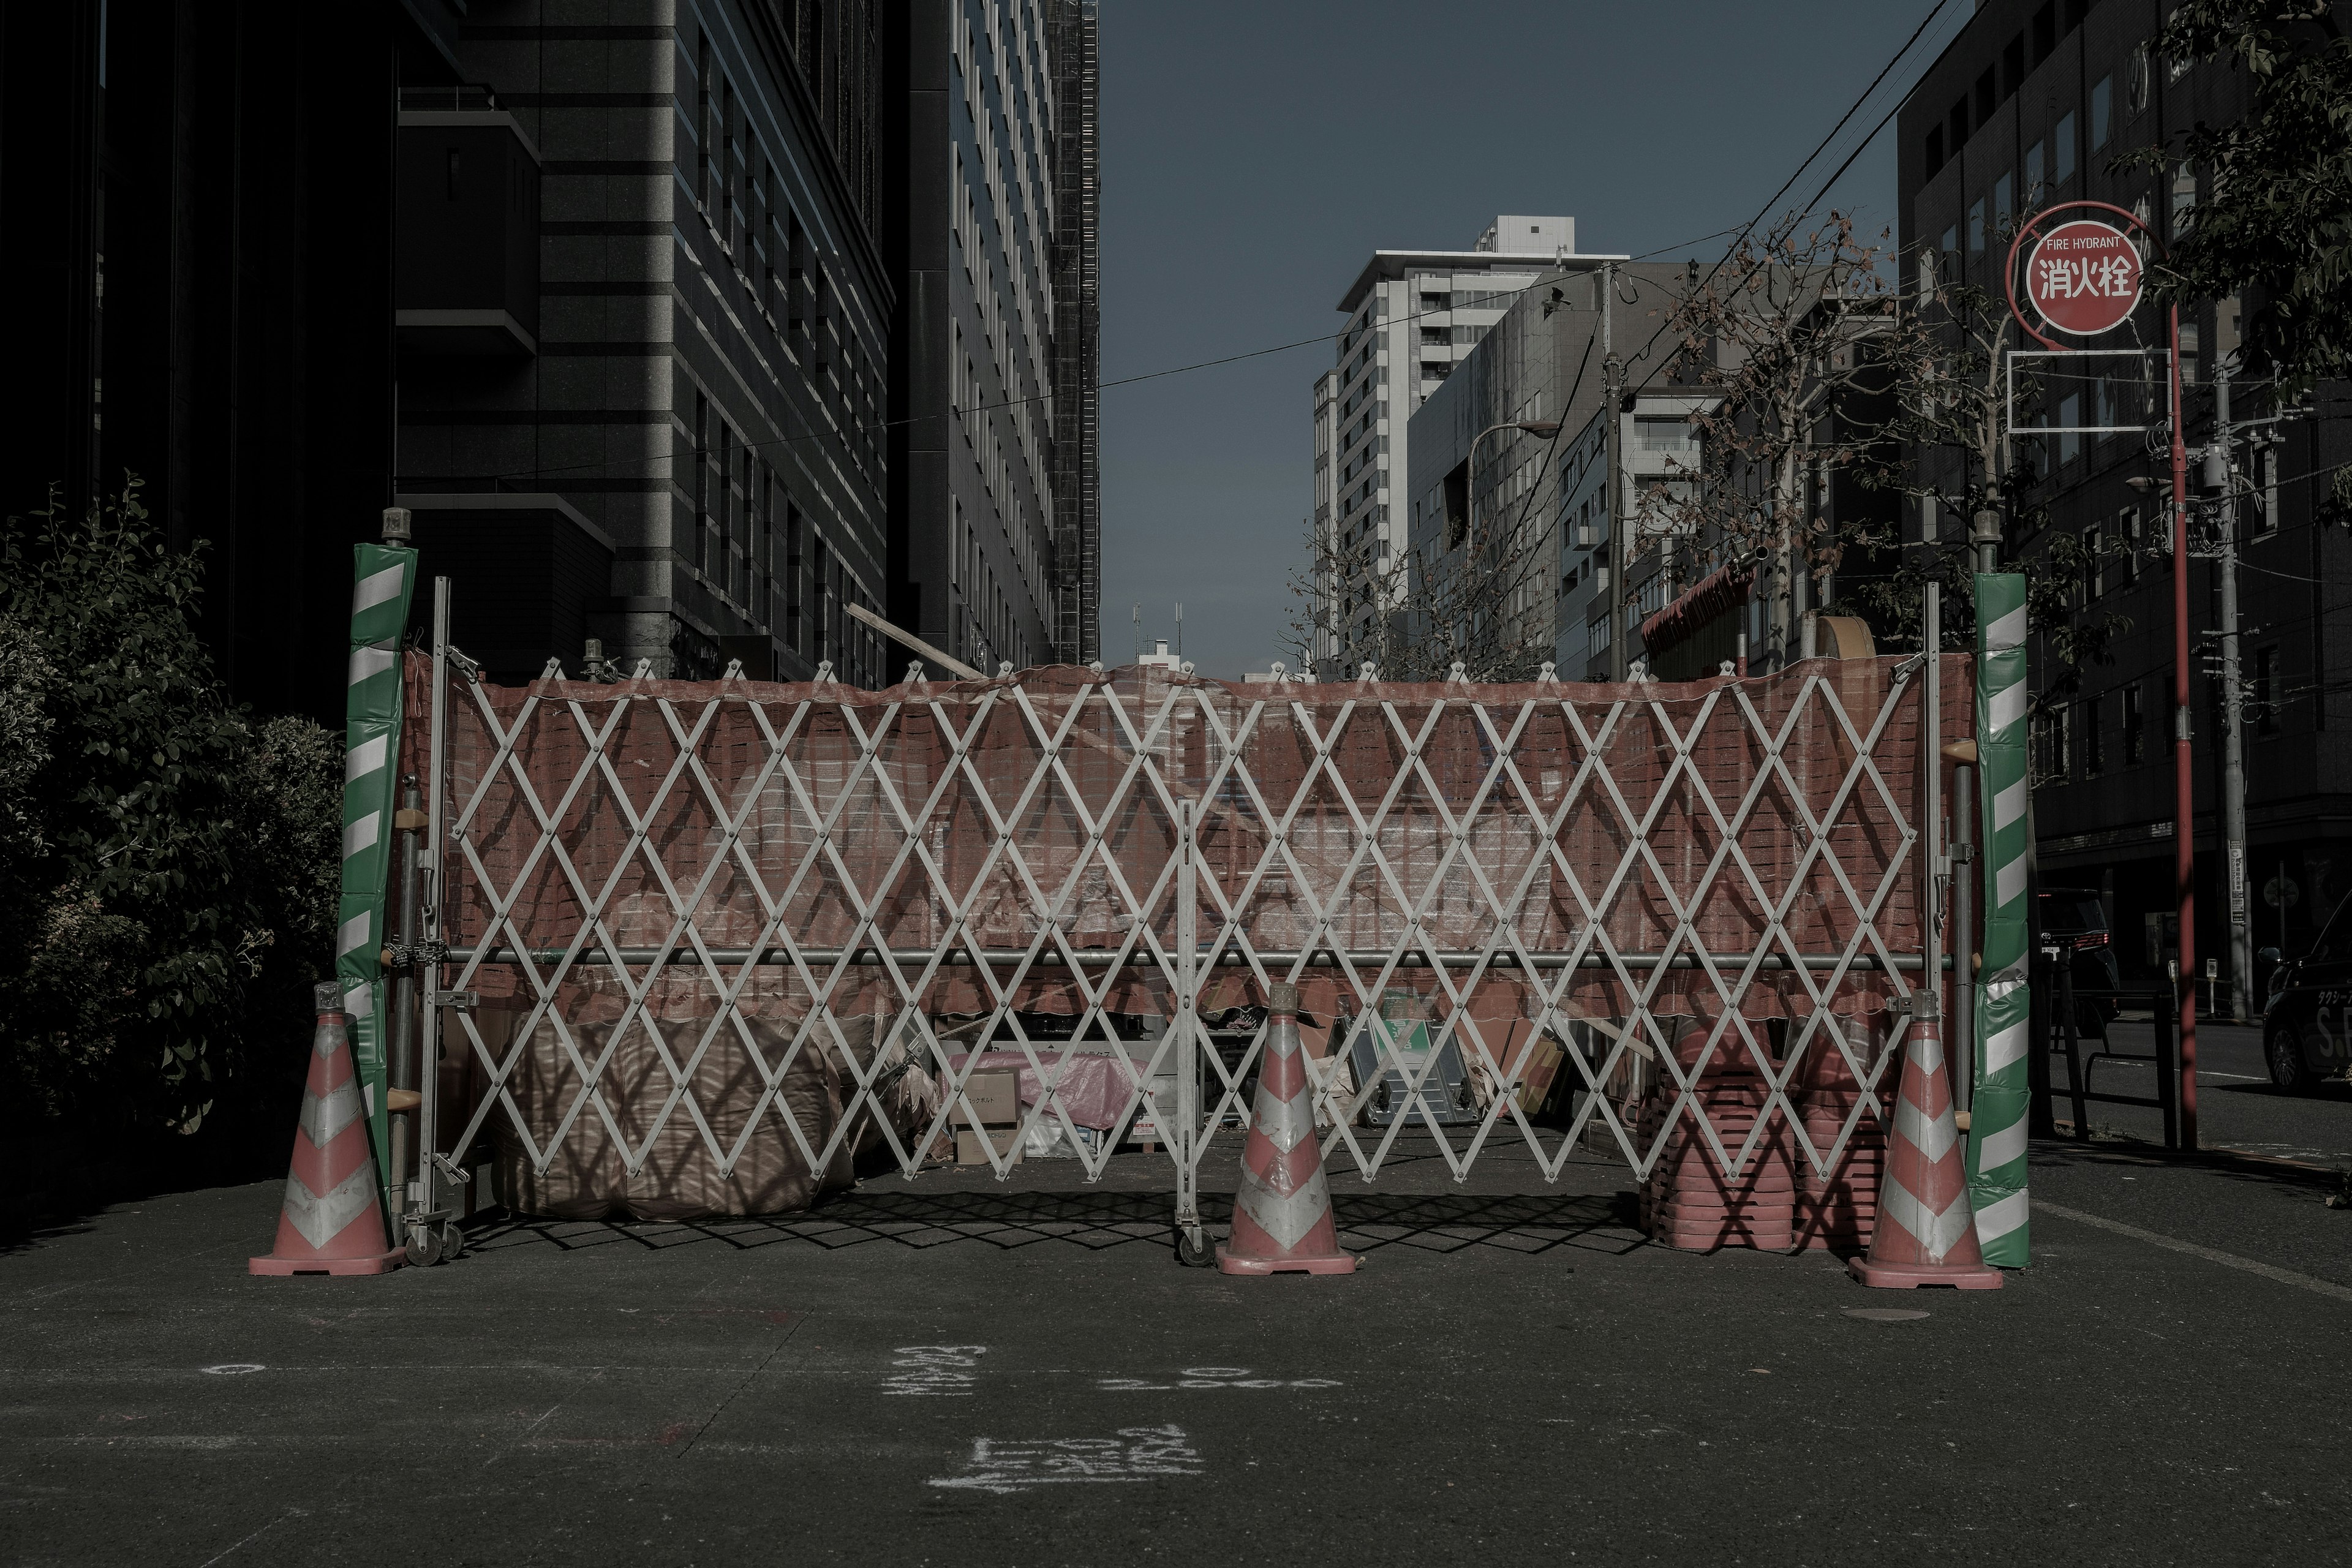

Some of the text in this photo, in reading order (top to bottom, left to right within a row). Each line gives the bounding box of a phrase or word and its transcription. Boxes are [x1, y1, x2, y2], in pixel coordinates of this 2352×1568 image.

[2047, 236, 2120, 251] FIRE HYDRANT
[2040, 255, 2132, 300] 消火栓
